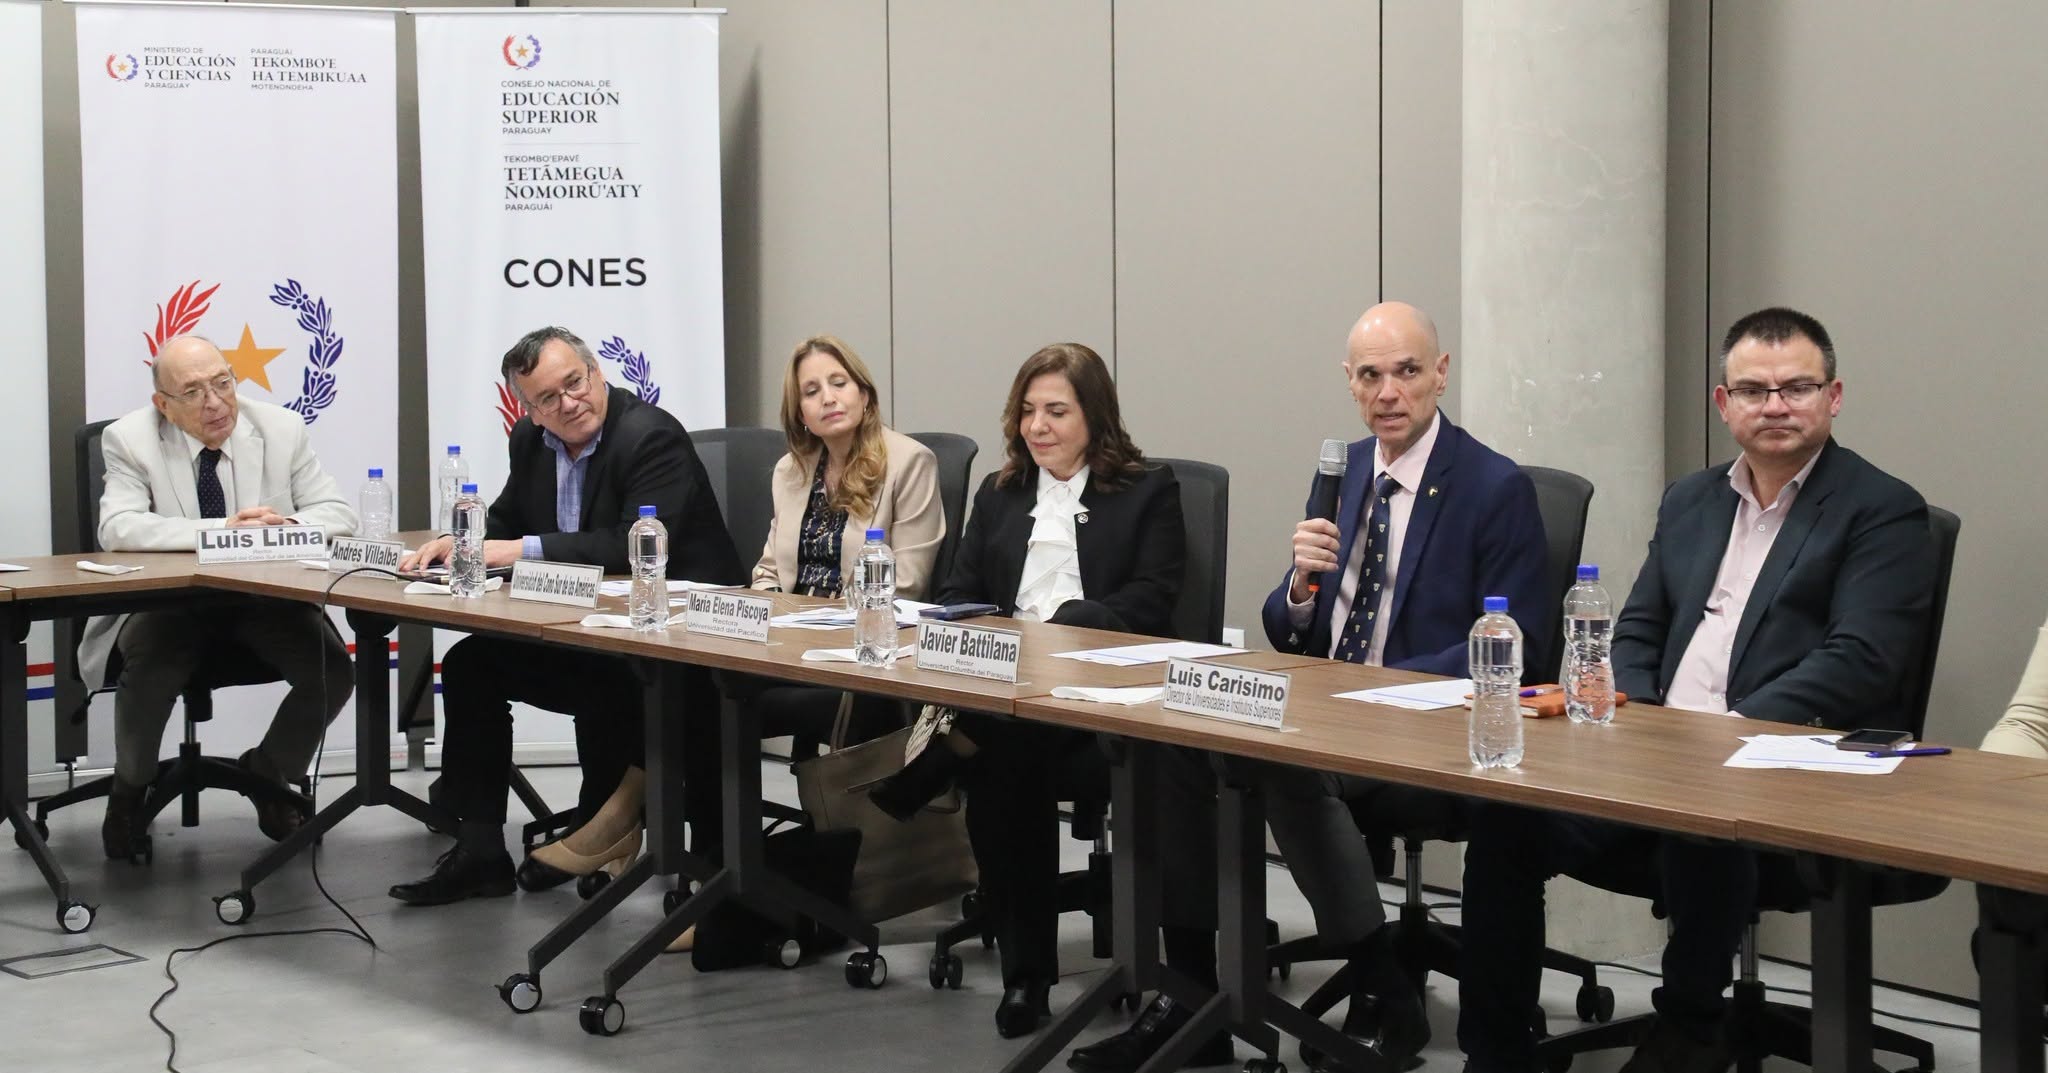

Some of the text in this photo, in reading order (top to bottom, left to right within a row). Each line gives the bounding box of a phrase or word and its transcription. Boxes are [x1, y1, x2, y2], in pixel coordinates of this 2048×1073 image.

[145, 54, 236, 67] EDUCACIÓN
[251, 57, 337, 68] TEKOMBO'E
[146, 69, 231, 80] Y CIENCIAS
[252, 70, 367, 83] HA TEMBIKUAA
[501, 80, 611, 88] CONSEJO NACIONAL DE
[502, 88, 620, 106] EDUCACIÓN
[502, 110, 598, 124] SUPERIOR
[504, 164, 624, 181] TETÃMEGUA
[504, 257, 647, 288] CONES
[201, 528, 324, 550] Luis Lima
[331, 540, 398, 567] Andrés Villalba
[689, 593, 769, 625] María Elena Piscoya
[688, 621, 725, 632] Universidad
[712, 617, 739, 627] Rectora
[921, 625, 1017, 663] Javier Battilana
[956, 658, 974, 667] Rector
[950, 664, 975, 674] Columbia
[987, 671, 1013, 681] Paraguay
[1168, 663, 1285, 702] Luis Carisimo
[1166, 685, 1185, 704] Director
[1185, 689, 1192, 705] de
[1192, 689, 1226, 712] Universidades
[1230, 698, 1252, 716] Institutos
[1253, 700, 1281, 721] Superiores
